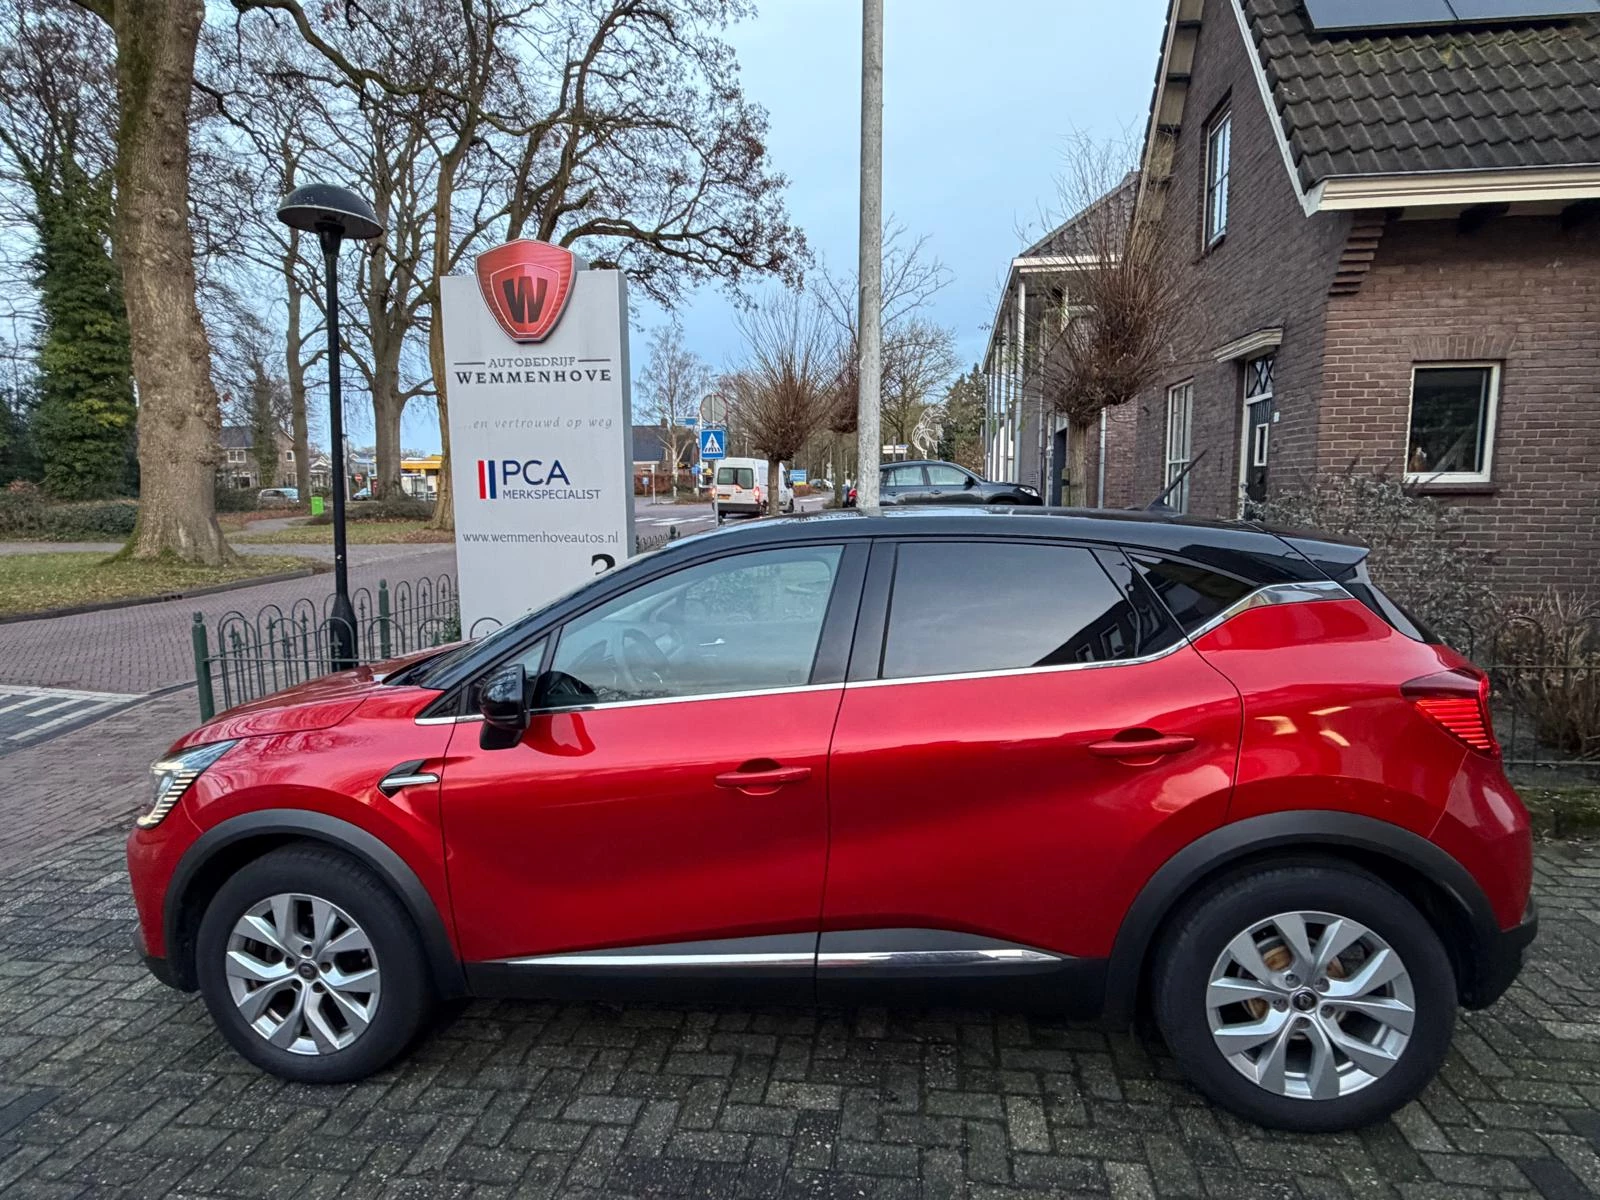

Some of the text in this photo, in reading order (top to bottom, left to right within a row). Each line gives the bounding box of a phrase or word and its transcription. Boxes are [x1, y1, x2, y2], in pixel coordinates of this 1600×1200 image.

[502, 276, 548, 323] W
[488, 356, 576, 369] AUTOBEDRIJF
[455, 369, 612, 385] WEMMENHOVE
[494, 415, 560, 429] vertrouwd
[566, 416, 582, 429] op
[588, 417, 612, 429] weg
[502, 459, 571, 486] PCA
[502, 489, 601, 500] MERKSPECIALIST
[462, 531, 619, 544] www.wemmenhoveautos.nl
